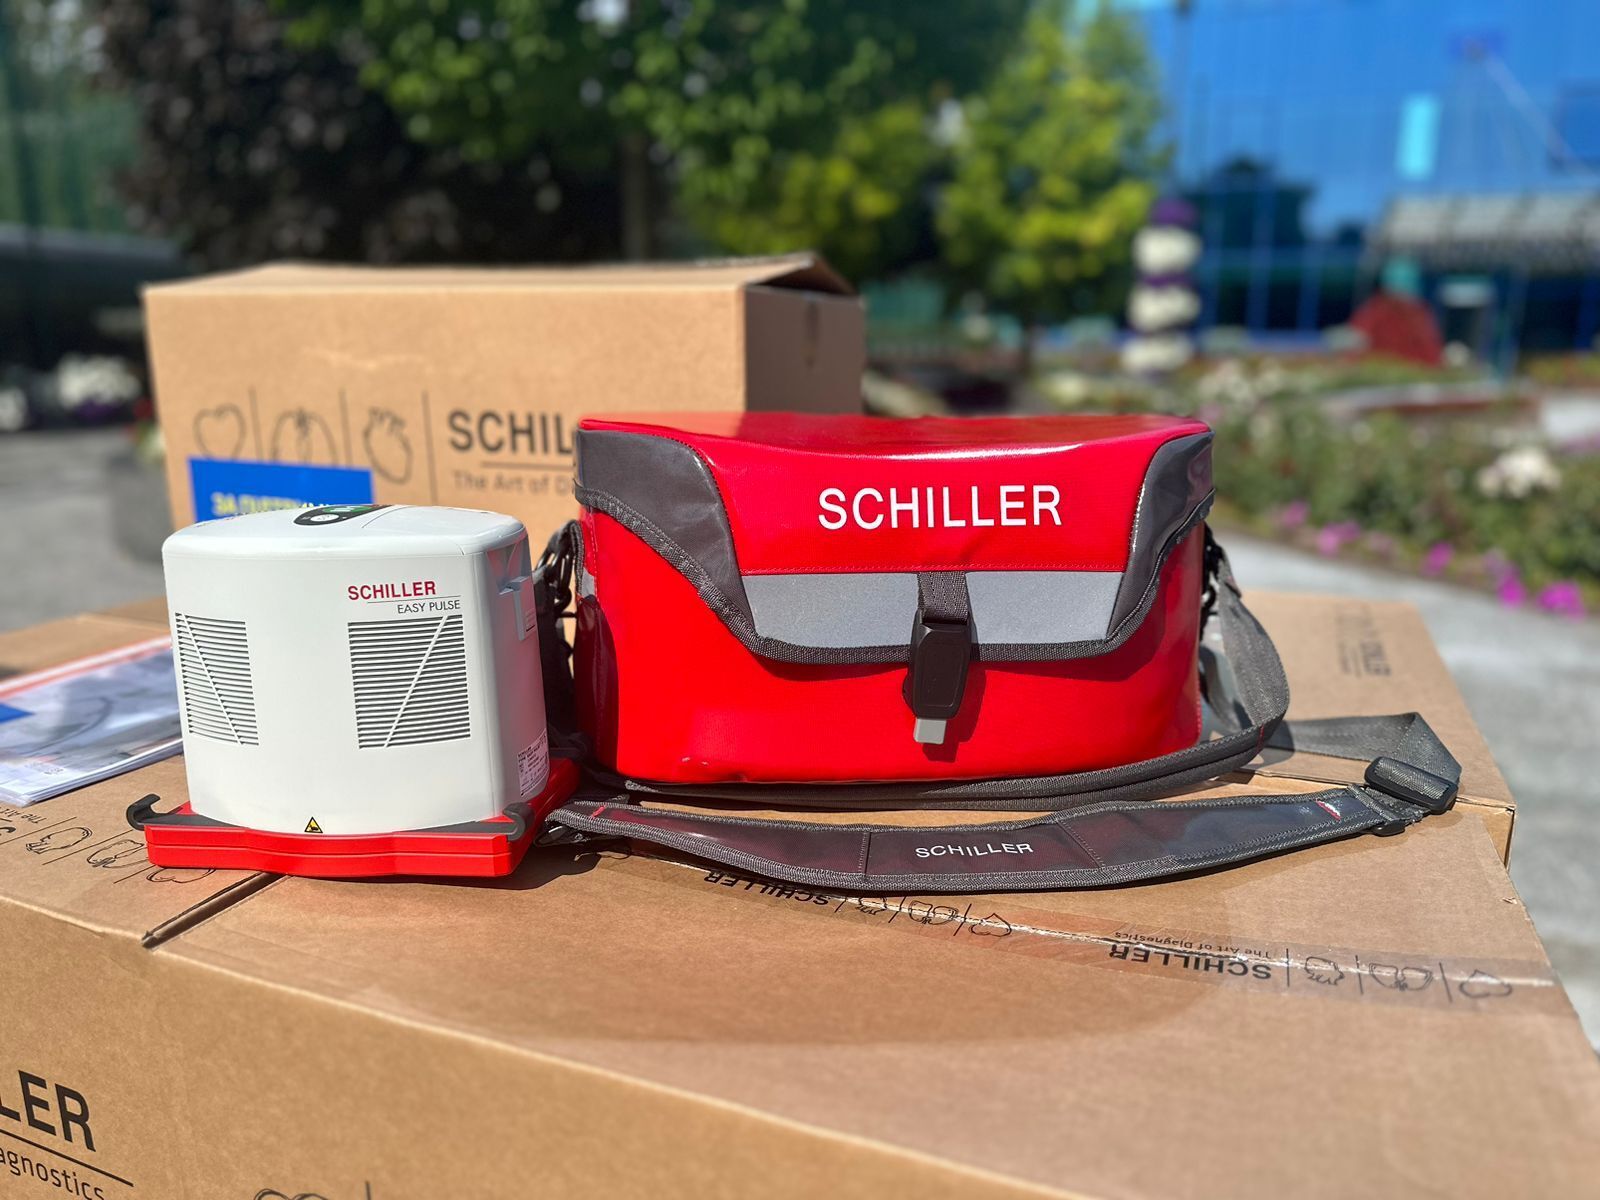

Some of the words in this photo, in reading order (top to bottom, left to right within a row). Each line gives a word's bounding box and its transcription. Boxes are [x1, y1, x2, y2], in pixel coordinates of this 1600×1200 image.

[453, 469, 485, 489] The
[494, 473, 523, 491] Art
[818, 485, 1062, 530] SCHILLER
[347, 581, 436, 601] SCHILLER
[397, 602, 426, 614] EASY
[429, 600, 461, 612] PULSE
[915, 843, 1034, 858] SCHILLER
[1115, 931, 1194, 949] Diagnostics
[1199, 943, 1213, 951] of
[1217, 945, 1240, 954] Art
[1244, 949, 1272, 960] The
[1109, 944, 1272, 980] SCHILLER
